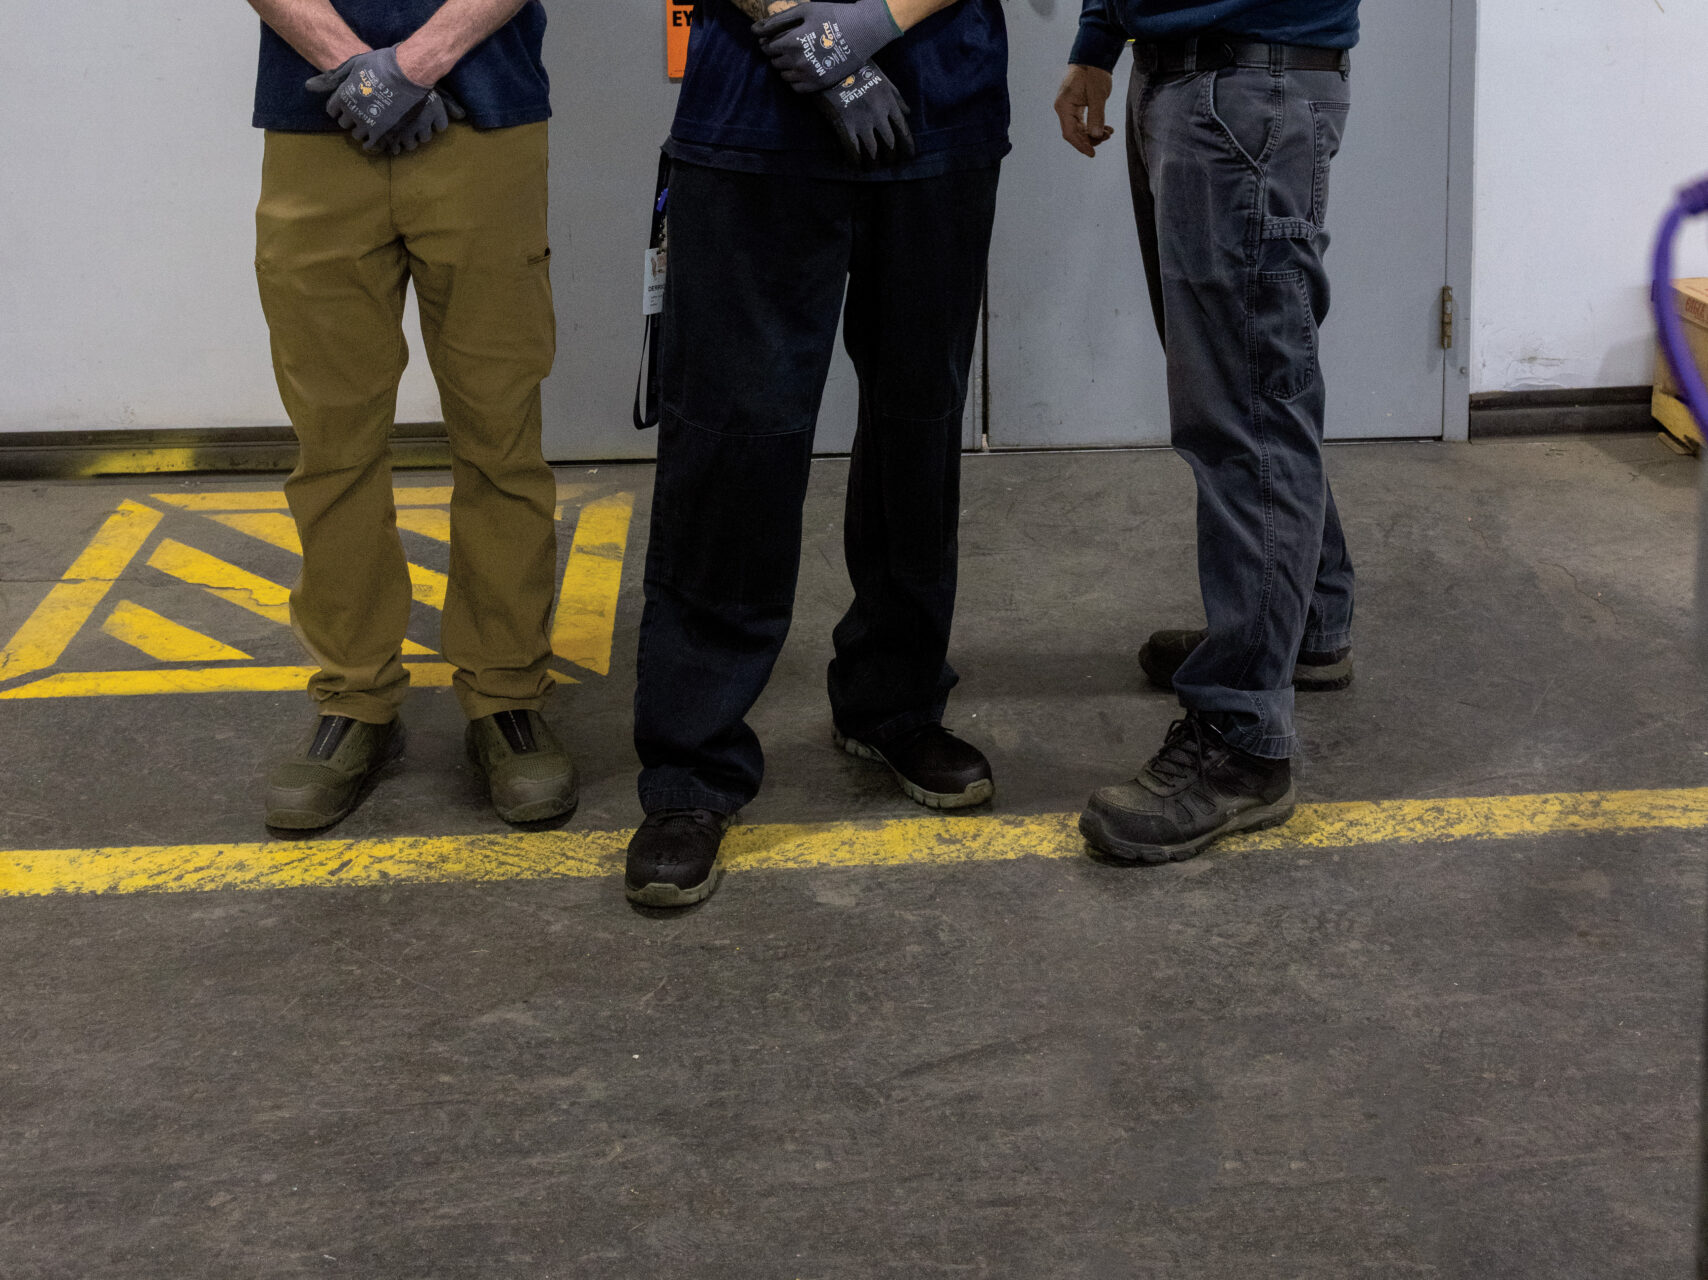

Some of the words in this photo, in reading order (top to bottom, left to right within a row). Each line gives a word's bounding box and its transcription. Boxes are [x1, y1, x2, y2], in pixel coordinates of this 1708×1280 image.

[672, 10, 694, 27] EY
[800, 36, 826, 76] MaxiFlex
[843, 75, 882, 105] MaxiFlex
